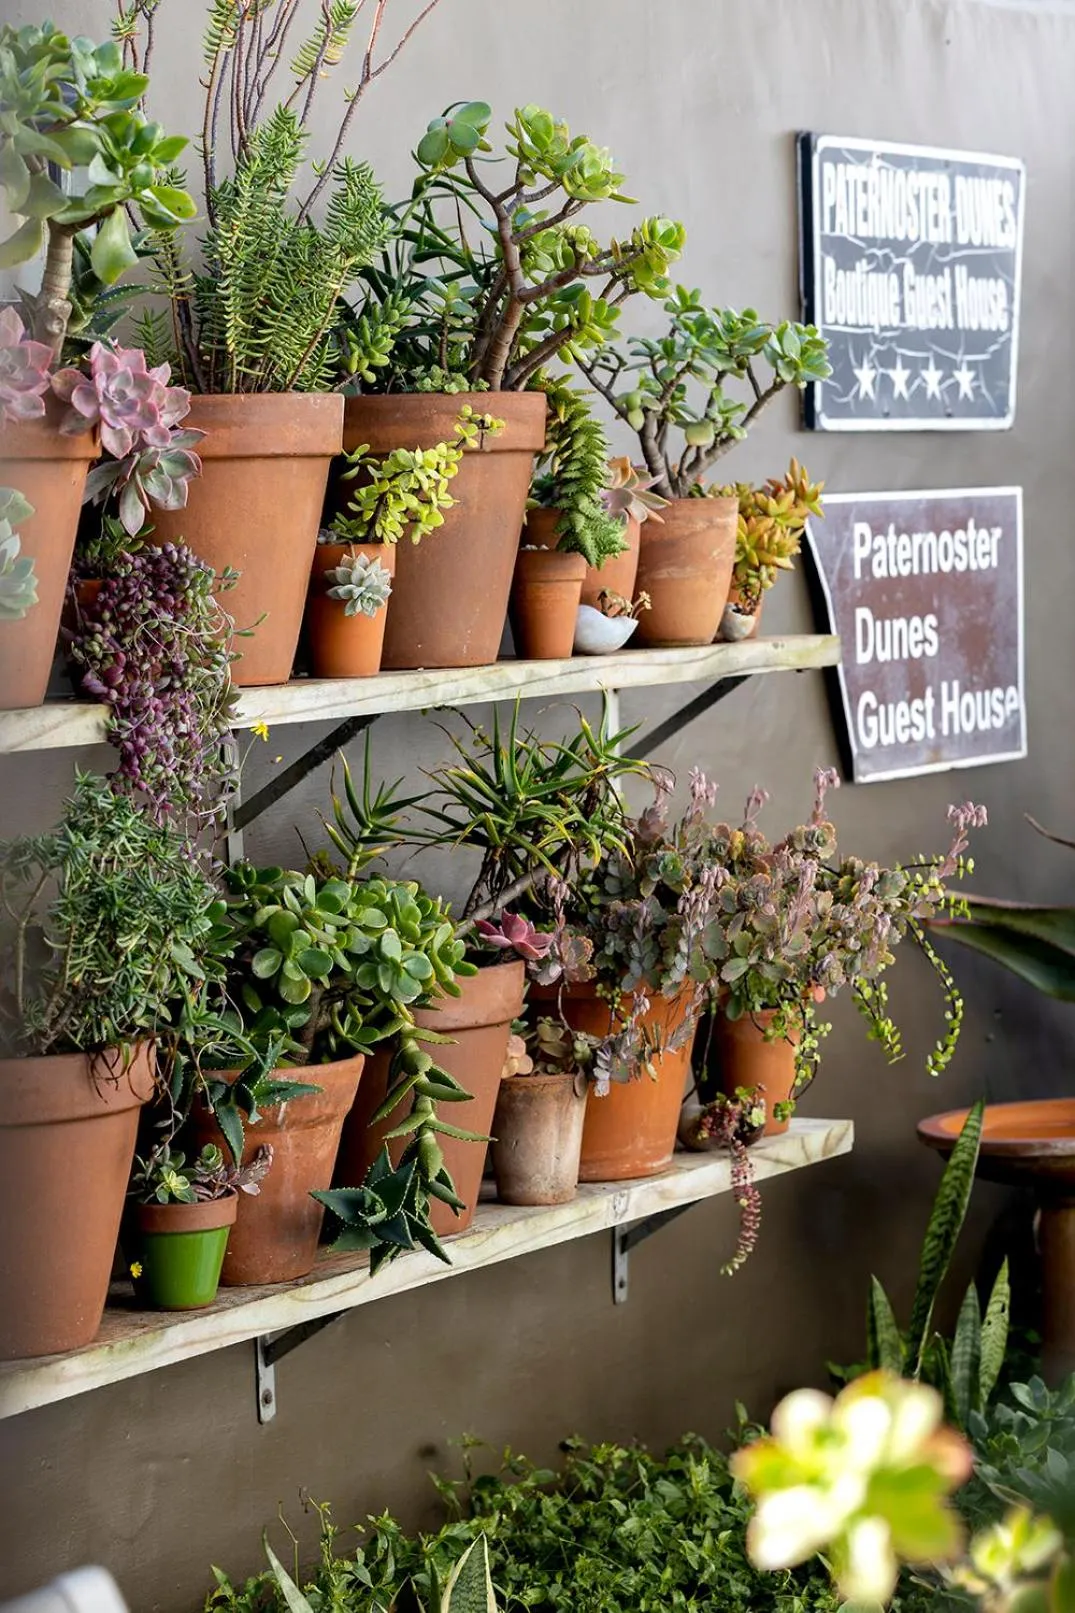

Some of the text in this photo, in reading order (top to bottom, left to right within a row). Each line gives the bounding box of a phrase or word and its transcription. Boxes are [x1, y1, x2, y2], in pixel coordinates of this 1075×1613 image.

[823, 162, 1016, 248] PATERNOSTER DUNES
[824, 257, 1008, 334] Boutique Guest House
[854, 518, 1002, 579] Paternoster
[855, 607, 939, 664] Dunes
[857, 680, 1020, 748] Guest House
